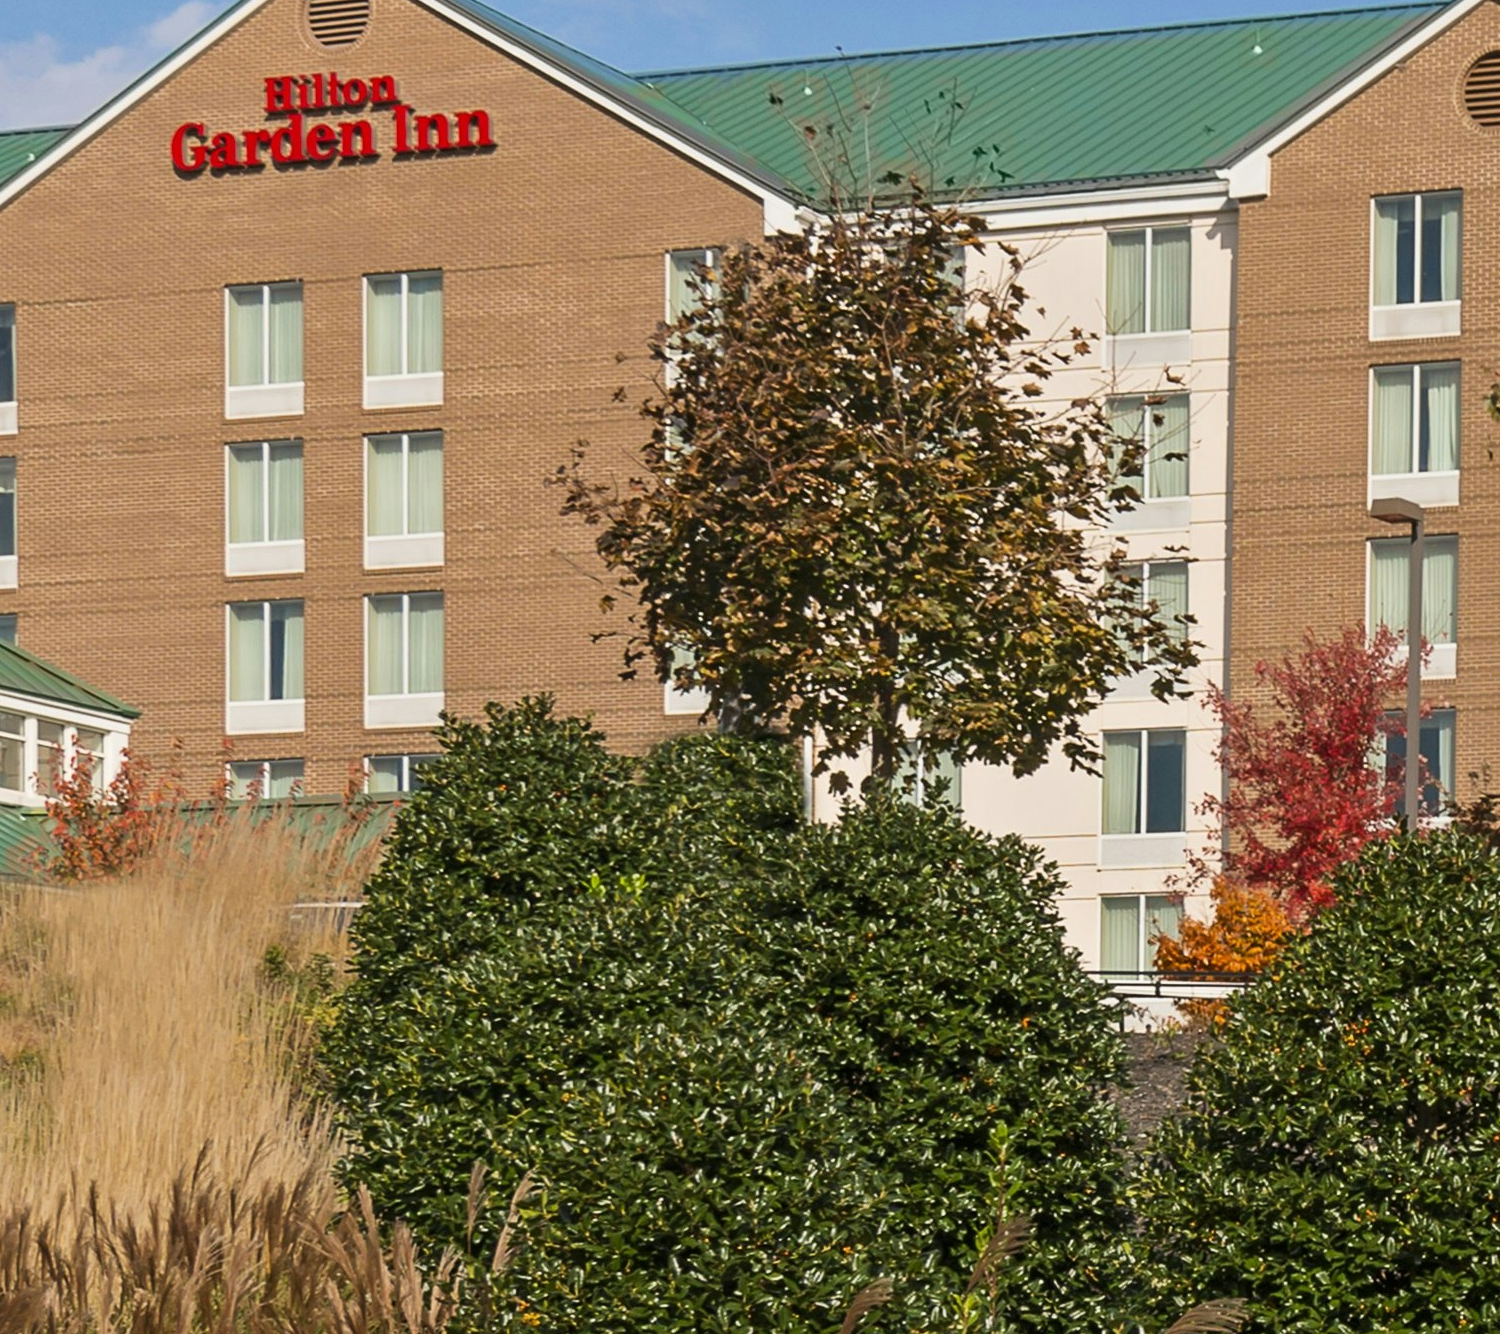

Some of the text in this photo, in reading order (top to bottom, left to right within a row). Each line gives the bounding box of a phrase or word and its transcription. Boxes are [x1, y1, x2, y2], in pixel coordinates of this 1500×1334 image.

[264, 72, 396, 113] Hilton
[171, 104, 492, 172] Garden Inn
